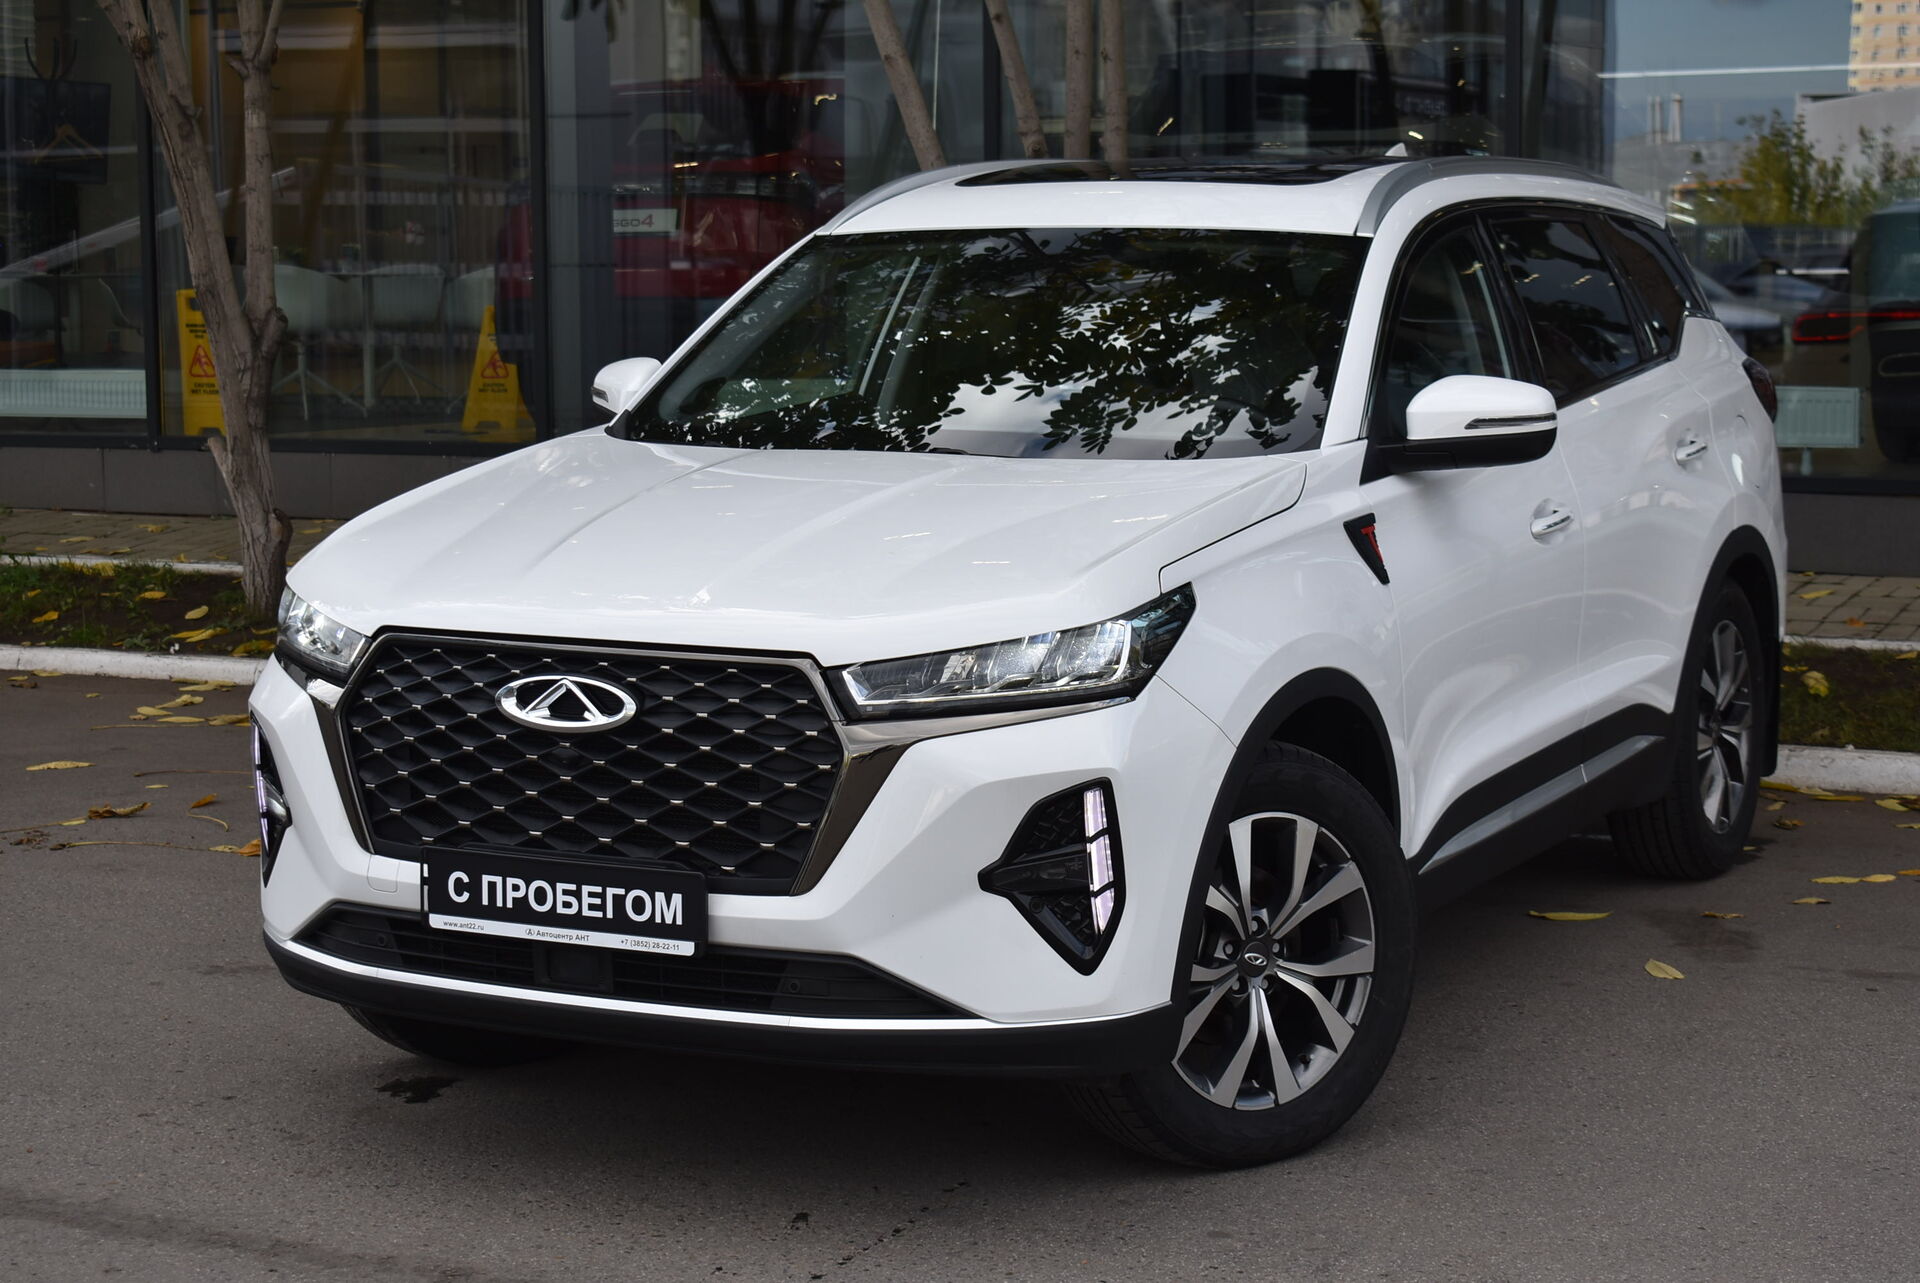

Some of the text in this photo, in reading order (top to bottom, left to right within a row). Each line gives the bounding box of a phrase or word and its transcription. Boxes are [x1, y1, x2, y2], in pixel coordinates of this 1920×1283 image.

[447, 871, 683, 925] С ПРОБЕГОМ
[443, 920, 485, 931] www.ant22.ru
[536, 930, 574, 941] Автоцентр
[575, 934, 590, 942] АНТ
[630, 940, 651, 949] (3852)
[652, 942, 680, 951] 28-22-11
